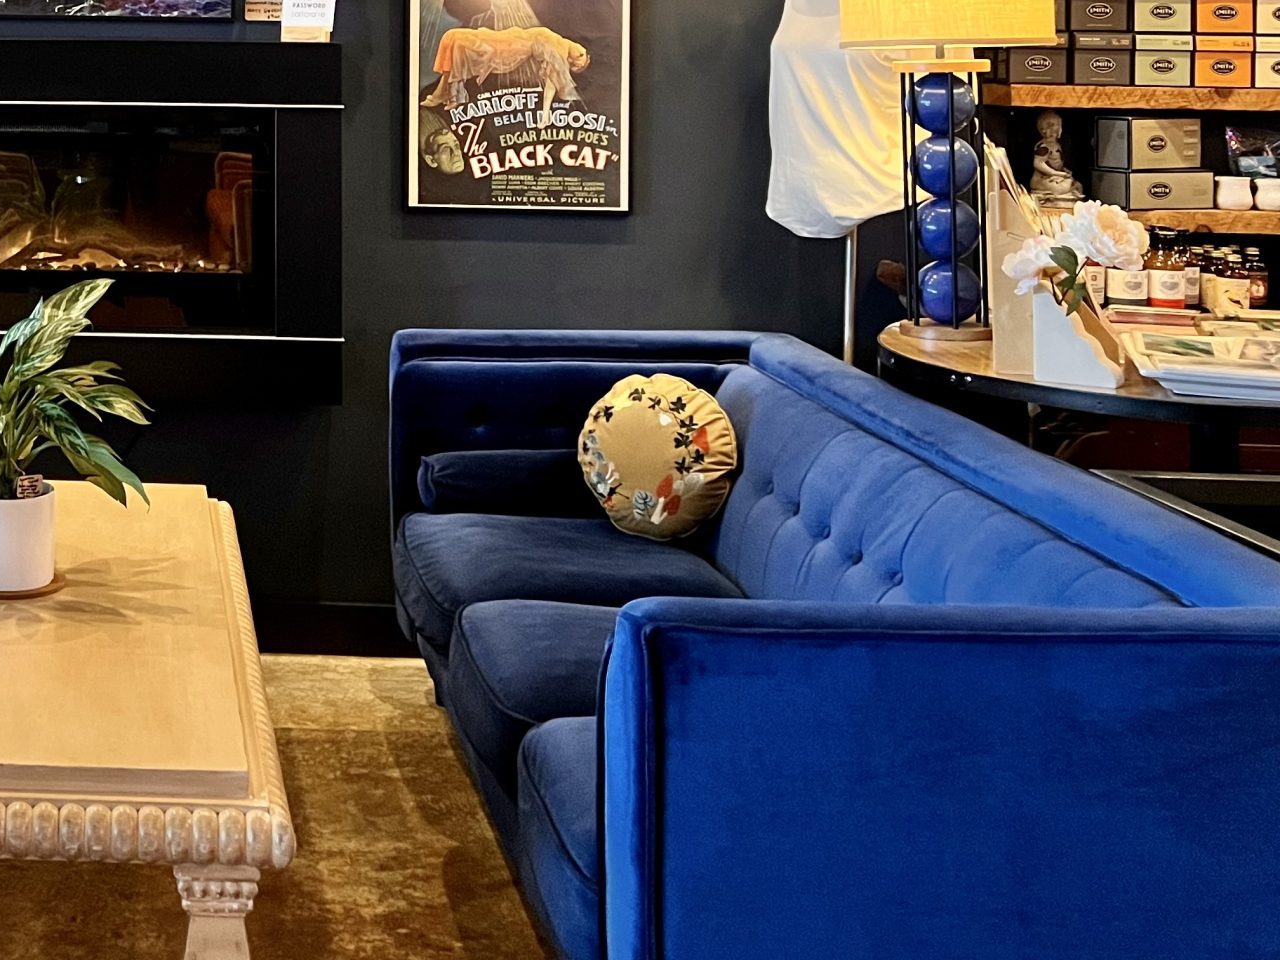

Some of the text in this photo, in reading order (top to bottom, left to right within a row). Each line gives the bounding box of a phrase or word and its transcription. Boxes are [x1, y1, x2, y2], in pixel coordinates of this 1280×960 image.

[449, 93, 539, 123] KARLOFF
[493, 112, 524, 127] BELA
[499, 128, 609, 147] EDGAR ALLAN POE'S
[469, 143, 554, 179] BLACK
